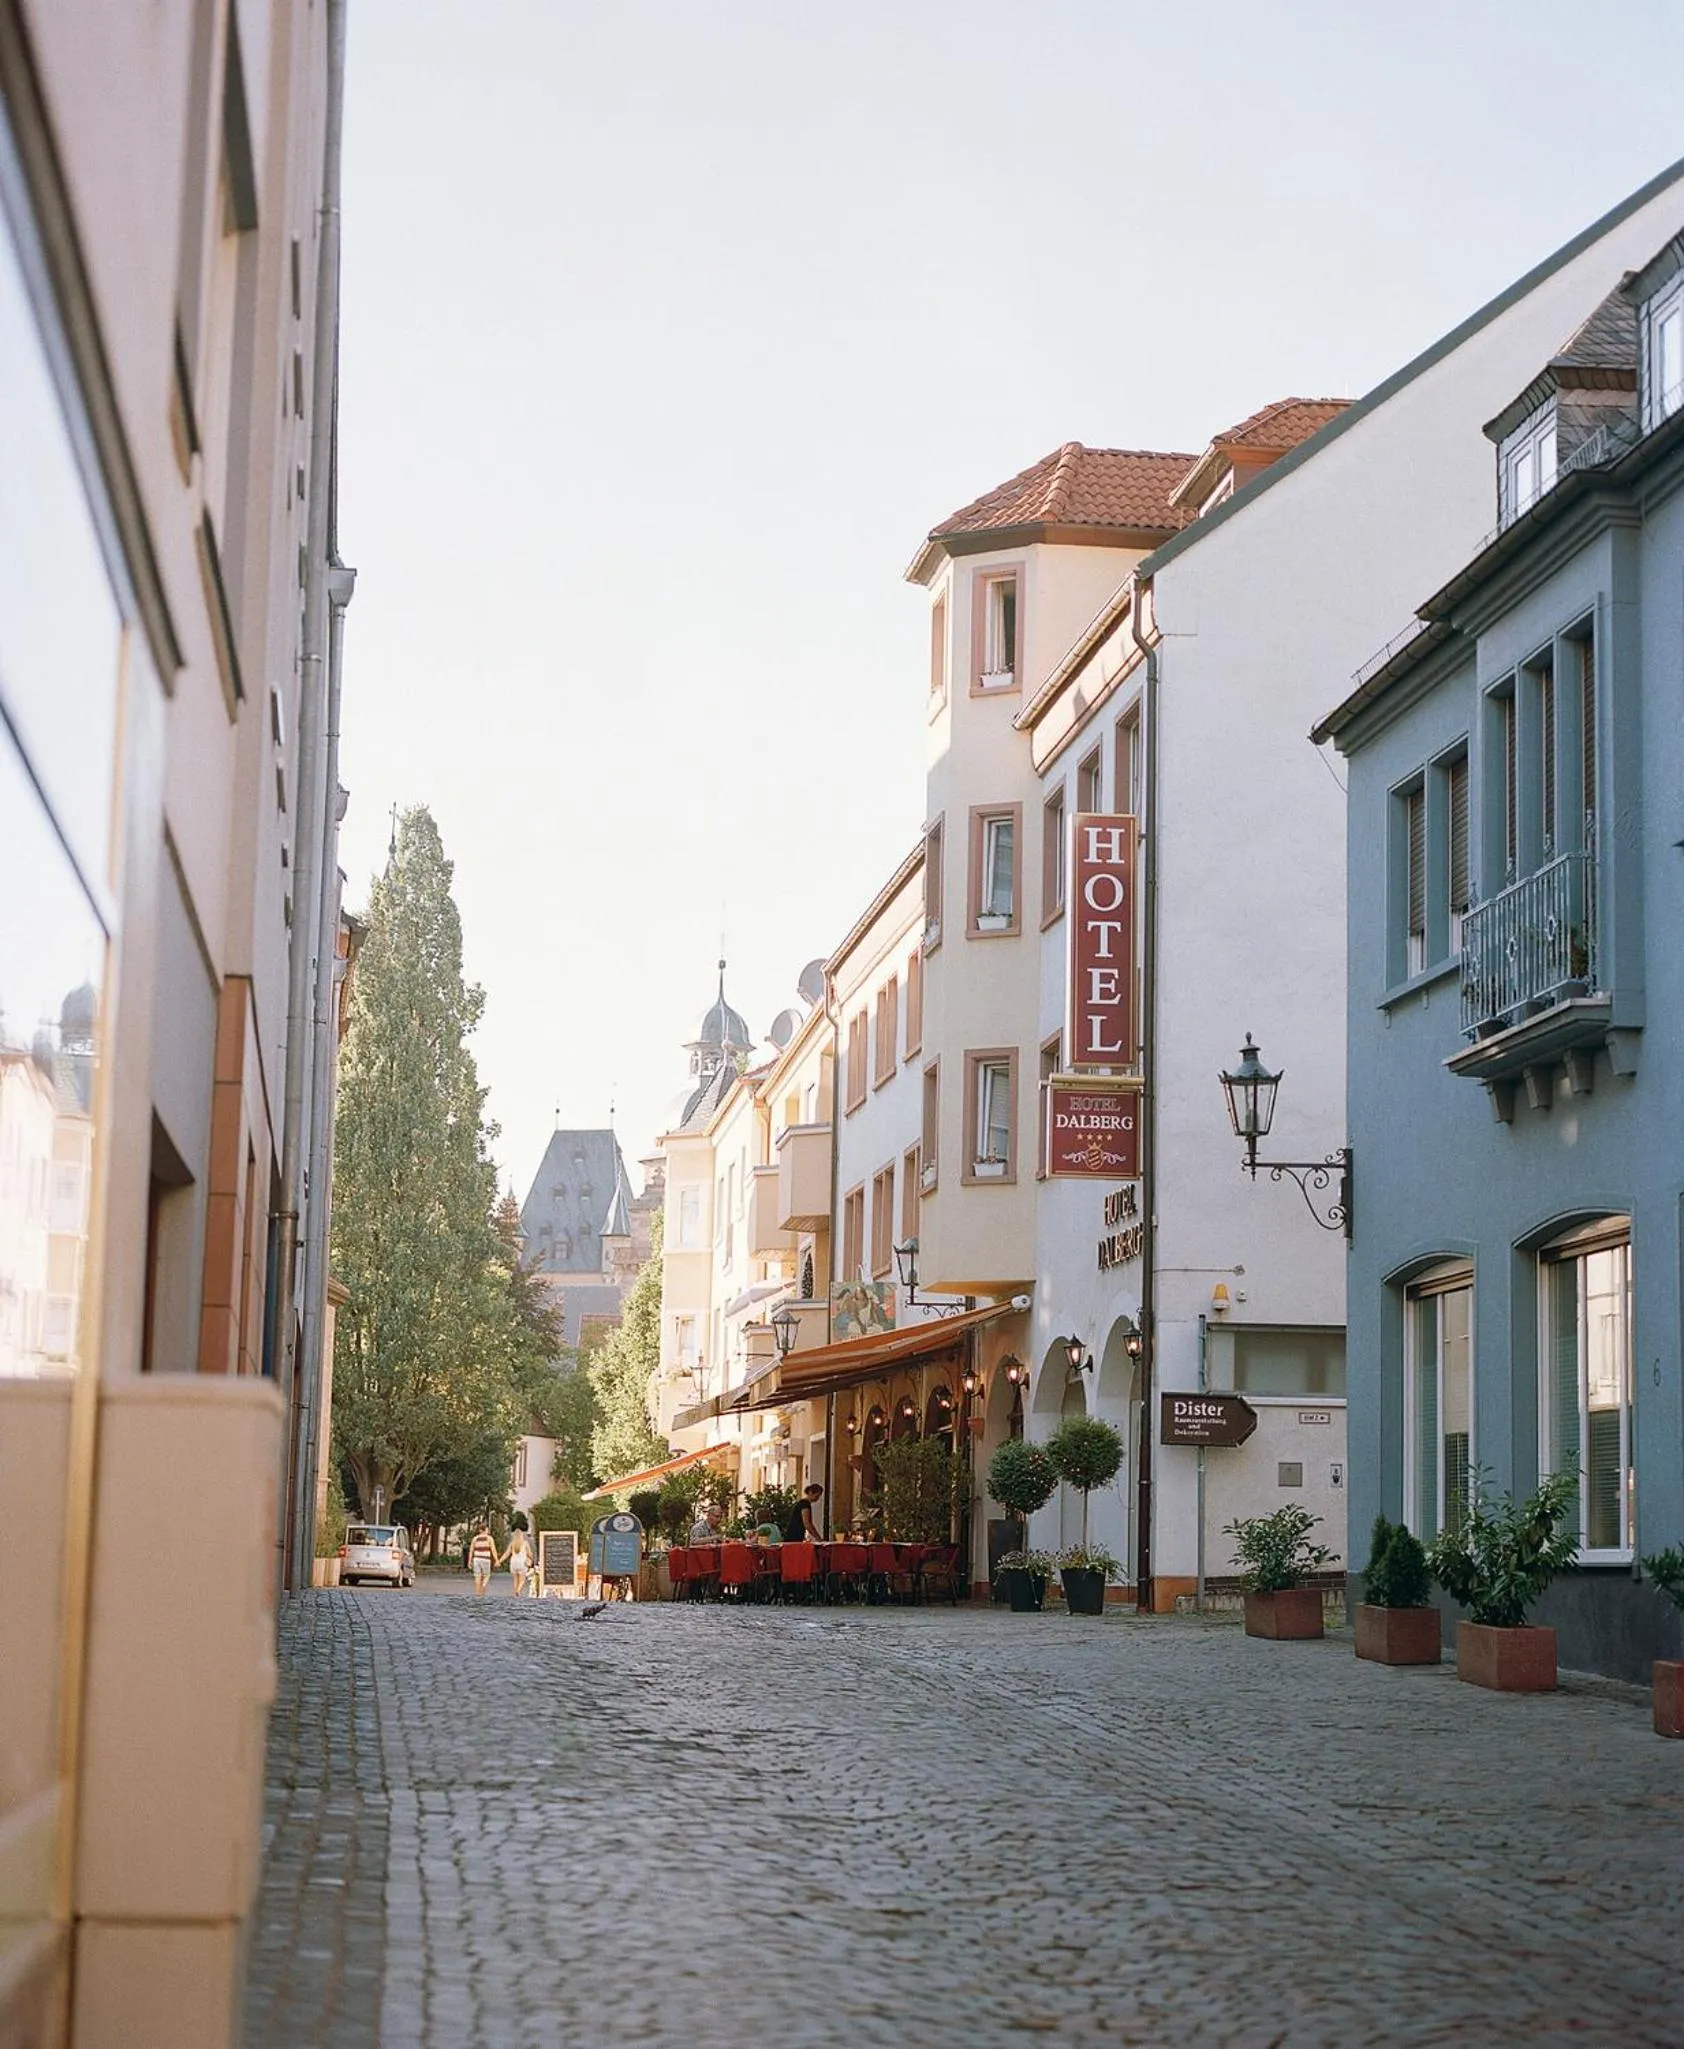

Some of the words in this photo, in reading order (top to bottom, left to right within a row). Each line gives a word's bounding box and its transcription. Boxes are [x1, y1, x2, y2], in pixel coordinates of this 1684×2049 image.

[1083, 826, 1125, 1052] HOTEL
[1069, 1096, 1121, 1111] HOTEL
[1056, 1114, 1134, 1130] DALBERG
[1104, 1184, 1137, 1226] HOTEL
[1653, 1358, 1661, 1387] 6
[1174, 1401, 1225, 1416] Dister
